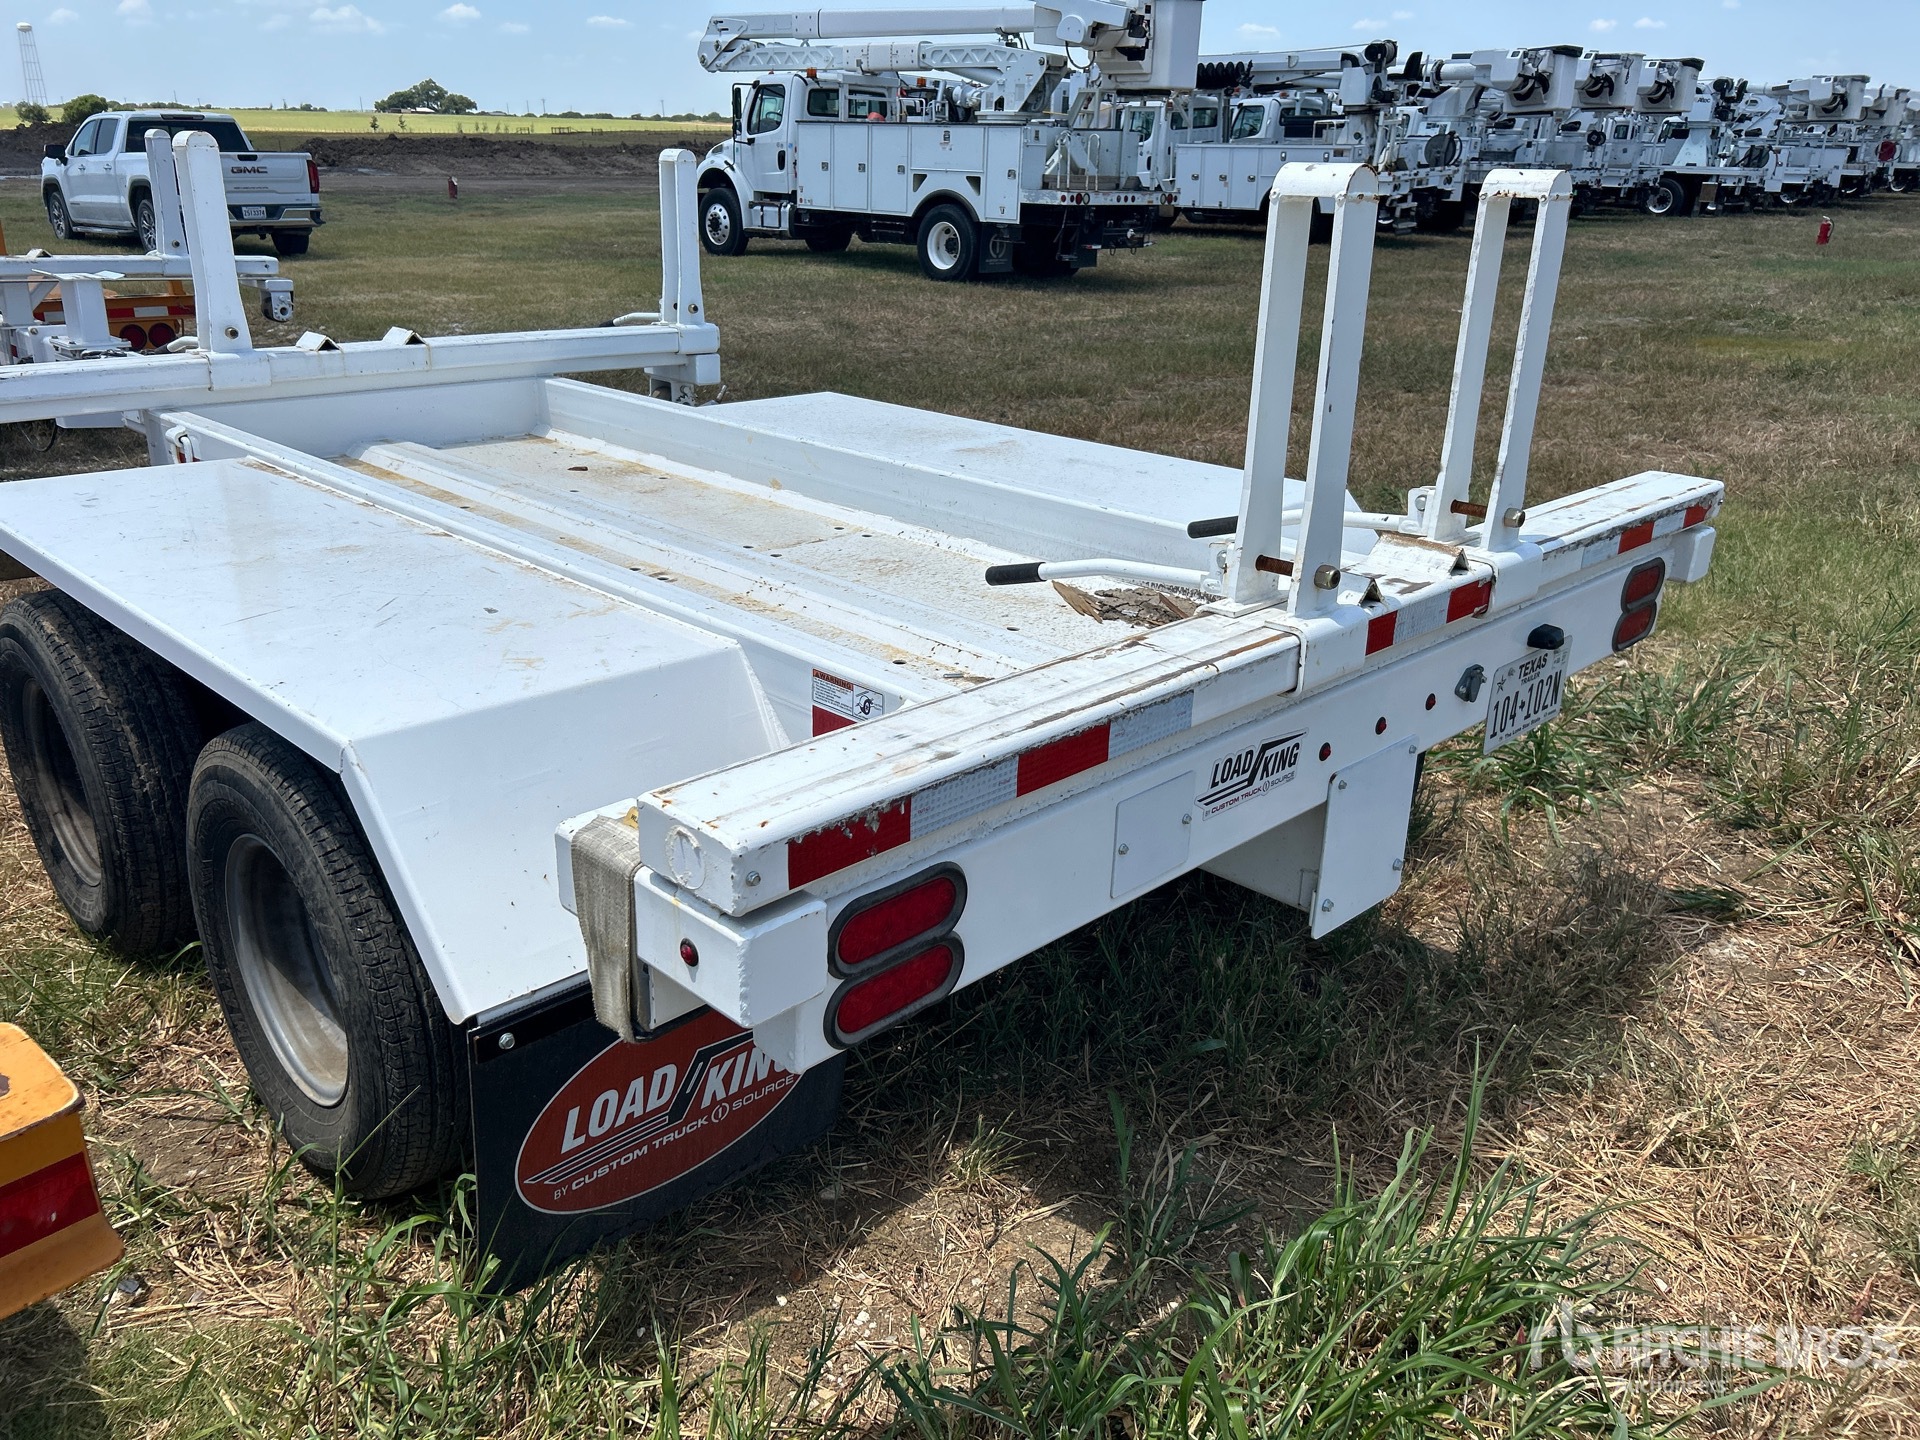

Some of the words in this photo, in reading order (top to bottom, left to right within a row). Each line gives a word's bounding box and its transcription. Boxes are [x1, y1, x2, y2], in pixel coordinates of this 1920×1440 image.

[231, 166, 268, 174] GMC
[1518, 653, 1548, 679] TEXAS
[1521, 671, 1541, 685] TRAILER
[1512, 726, 1522, 735] Lone
[1522, 721, 1530, 730] Star
[1210, 749, 1254, 789] LOAD
[1260, 742, 1300, 782] KING
[1211, 796, 1240, 814] CUSTOM
[1241, 786, 1262, 801] TRUCK
[1270, 771, 1295, 787] SOURCE
[560, 1063, 678, 1154] LOAD
[553, 1185, 569, 1201] BY
[571, 1145, 649, 1192] CUSTOM
[652, 1117, 710, 1150] TRUCK
[732, 1074, 795, 1110] SOURCE
